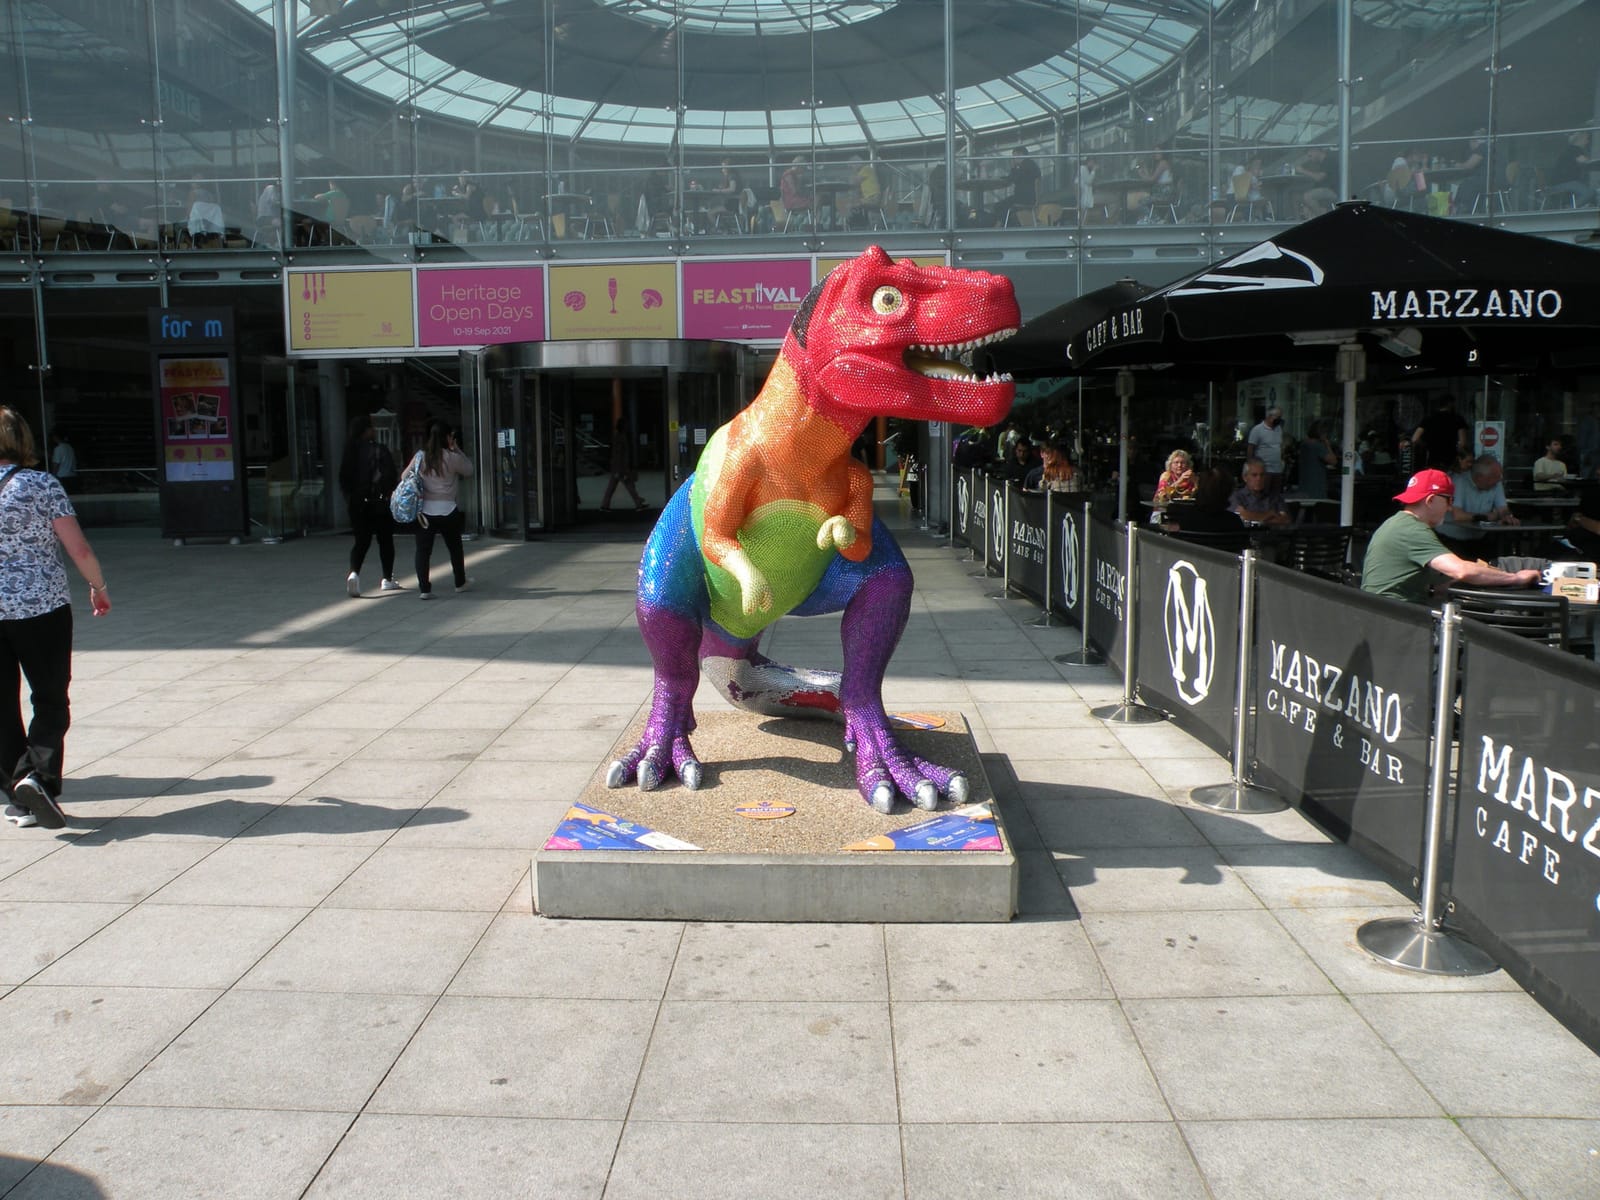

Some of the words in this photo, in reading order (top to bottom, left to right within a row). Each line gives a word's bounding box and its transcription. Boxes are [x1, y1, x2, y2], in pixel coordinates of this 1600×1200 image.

[441, 283, 521, 303] Heritage
[1371, 288, 1563, 320] MARZANO
[430, 304, 481, 323] Open
[487, 303, 534, 322] Days
[1122, 308, 1144, 337] BAR
[453, 327, 473, 336] 10-19
[473, 326, 491, 337] Sep
[492, 325, 512, 336] 2021
[1270, 639, 1402, 743] MARZANO
[1266, 688, 1317, 734] CAFE
[1332, 723, 1344, 749] &
[1359, 737, 1404, 784] BAR
[1476, 806, 1561, 885] CAFE
